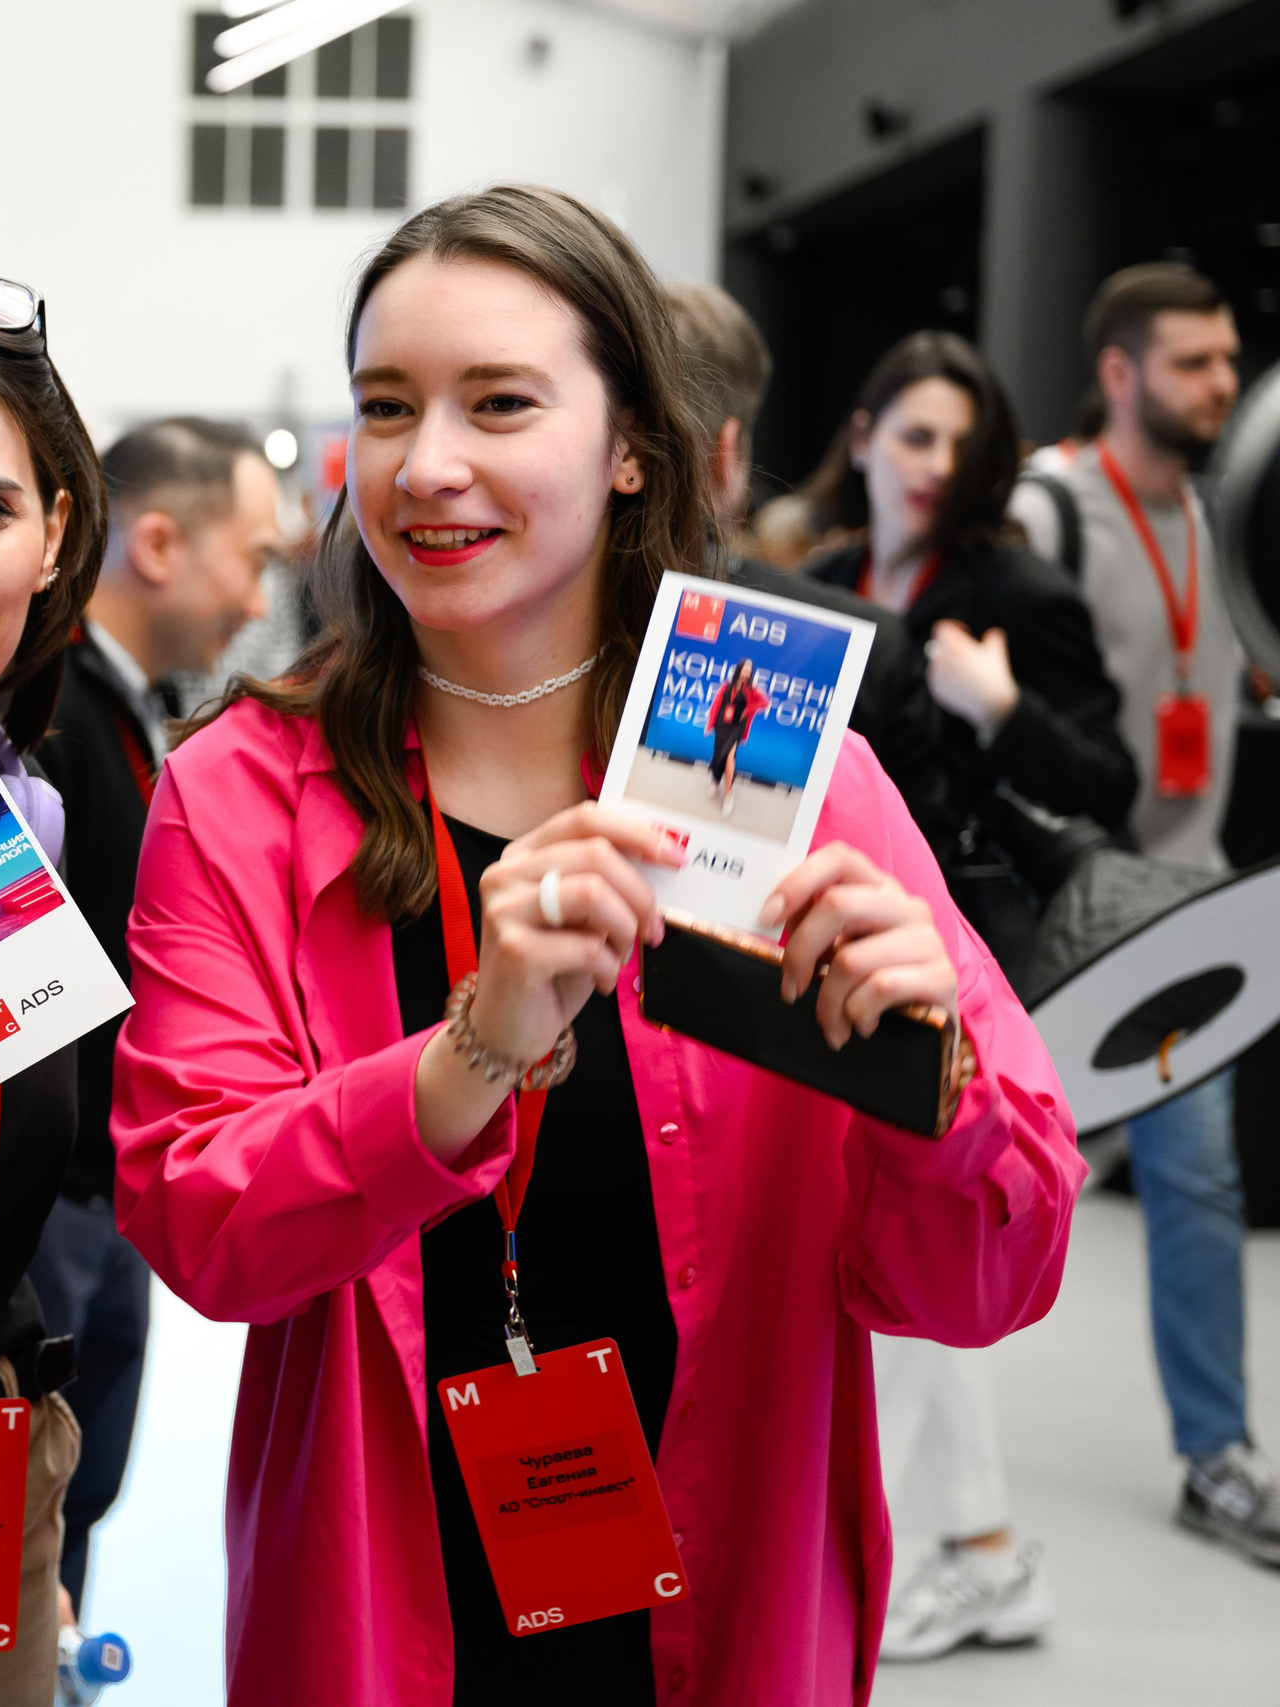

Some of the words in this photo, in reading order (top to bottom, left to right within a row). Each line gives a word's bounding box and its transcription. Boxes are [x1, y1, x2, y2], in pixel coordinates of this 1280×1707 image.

[728, 612, 788, 647] ADS
[20, 979, 64, 1015] ADS
[519, 1446, 593, 1470] Чураева
[526, 1467, 597, 1489] Евгения
[499, 1501, 520, 1514] АО
[522, 1477, 635, 1508] "Спорт-инвест"
[516, 1607, 565, 1632] ADS
